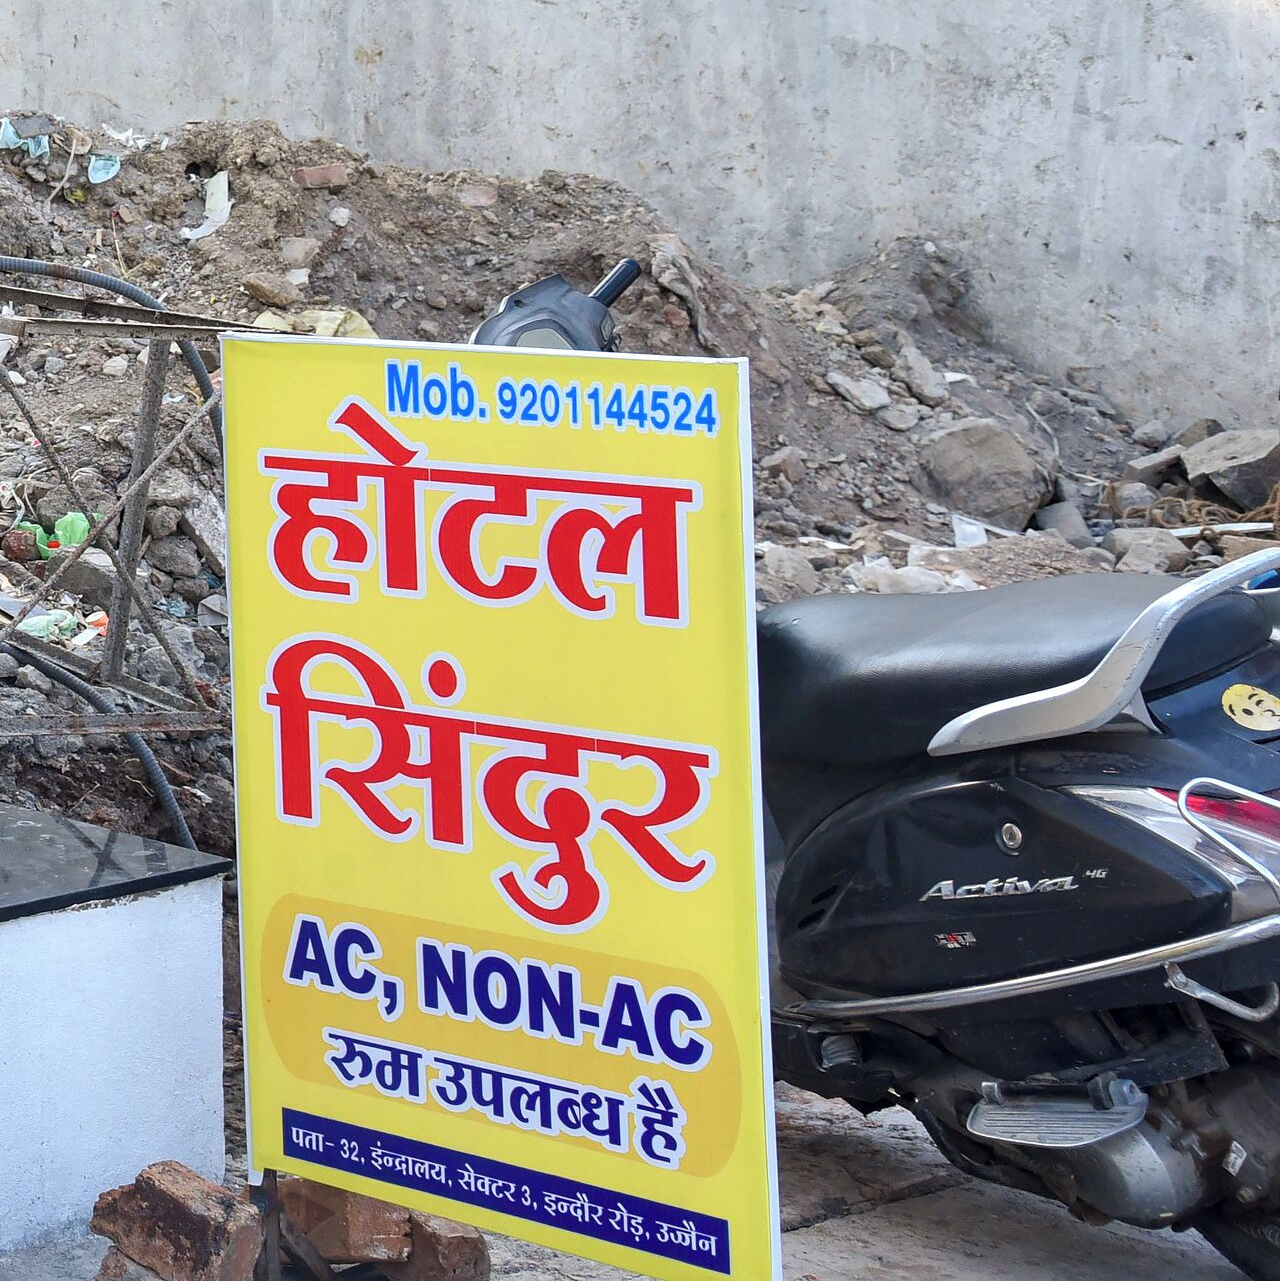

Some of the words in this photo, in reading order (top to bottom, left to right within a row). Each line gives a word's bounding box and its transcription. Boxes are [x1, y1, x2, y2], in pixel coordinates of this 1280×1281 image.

[387, 363, 487, 418] Mob.
[497, 381, 717, 433] 9201144524
[265, 403, 693, 619] होटल
[267, 639, 708, 925] सिंदुर
[920, 875, 1079, 902] Activa
[289, 920, 398, 1015] AC,
[421, 943, 704, 1065] NON-AC
[328, 1033, 423, 1097] रुम
[433, 1056, 625, 1147] उपलब्ध
[636, 1083, 679, 1163] है
[340, 1138, 365, 1164] 32,
[456, 1162, 516, 1202] सेक्टर
[521, 1185, 538, 1210] 3,
[542, 1191, 604, 1226] इन्दौर
[655, 1219, 718, 1256] उज्जैन
